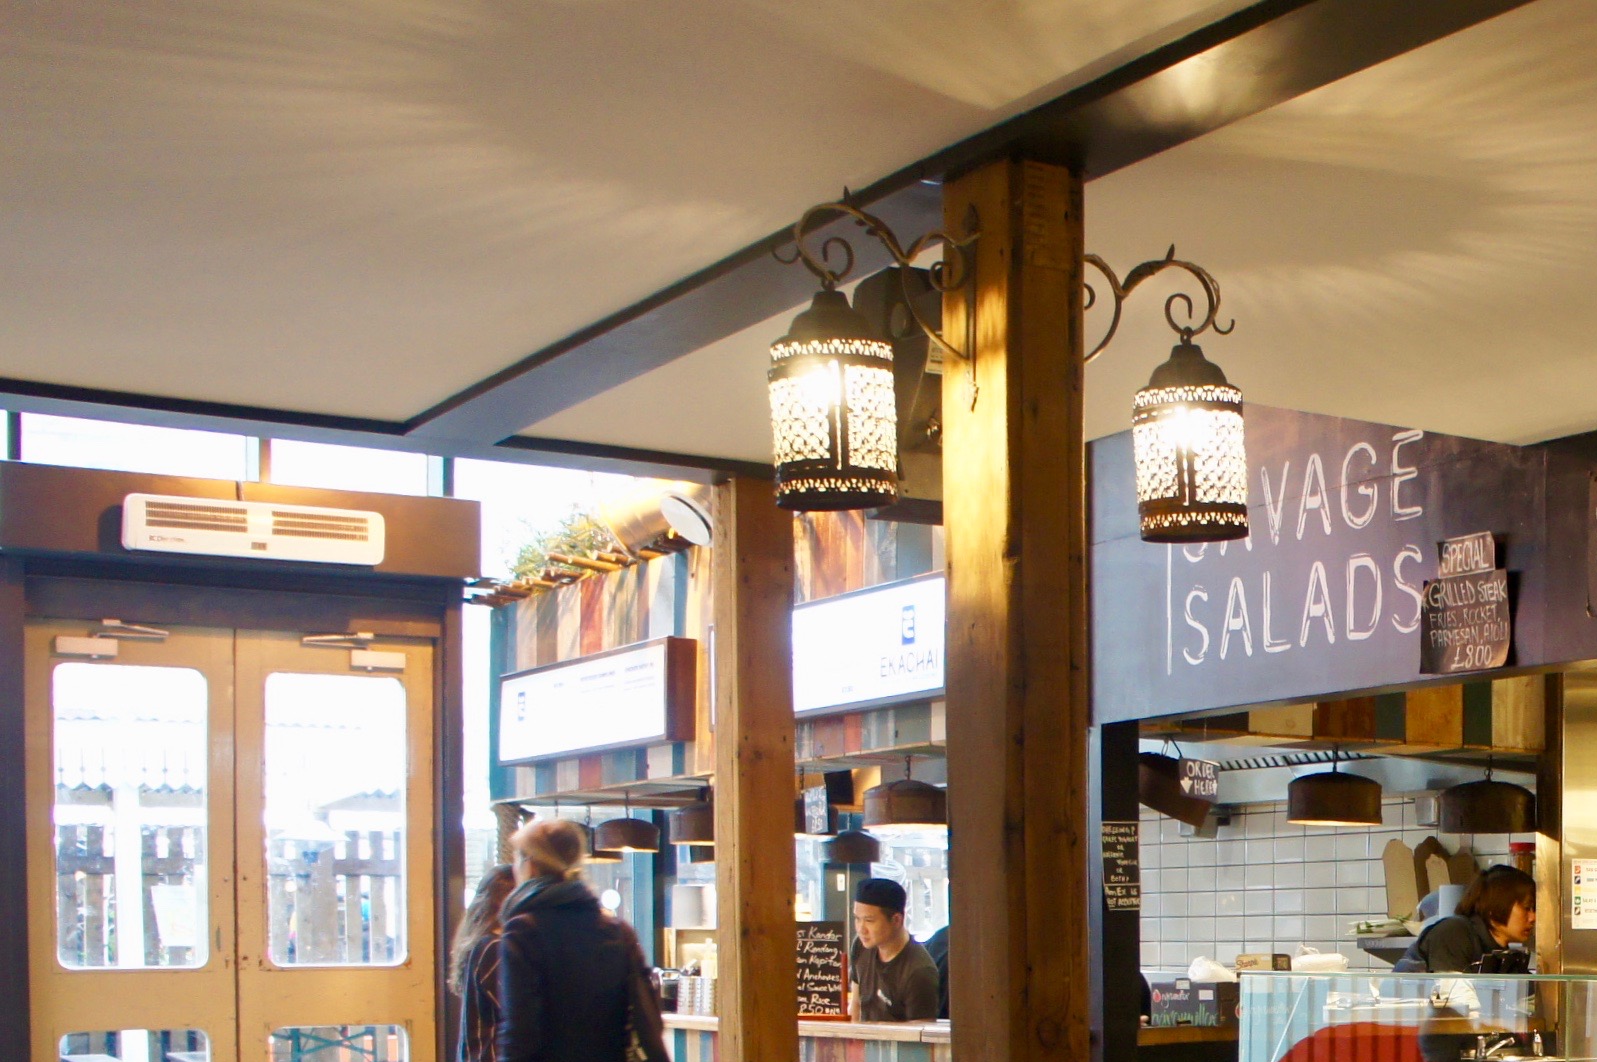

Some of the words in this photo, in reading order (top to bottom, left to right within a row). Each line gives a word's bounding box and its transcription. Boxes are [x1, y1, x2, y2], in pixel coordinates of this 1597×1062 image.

[1441, 537, 1490, 573] SPECIAL
[1183, 544, 1424, 666] SALADS
[1428, 580, 1476, 610] GRILLED
[1477, 578, 1507, 603] STEAK
[880, 649, 938, 678] EKACHAI
[1187, 760, 1216, 779] ORDER
